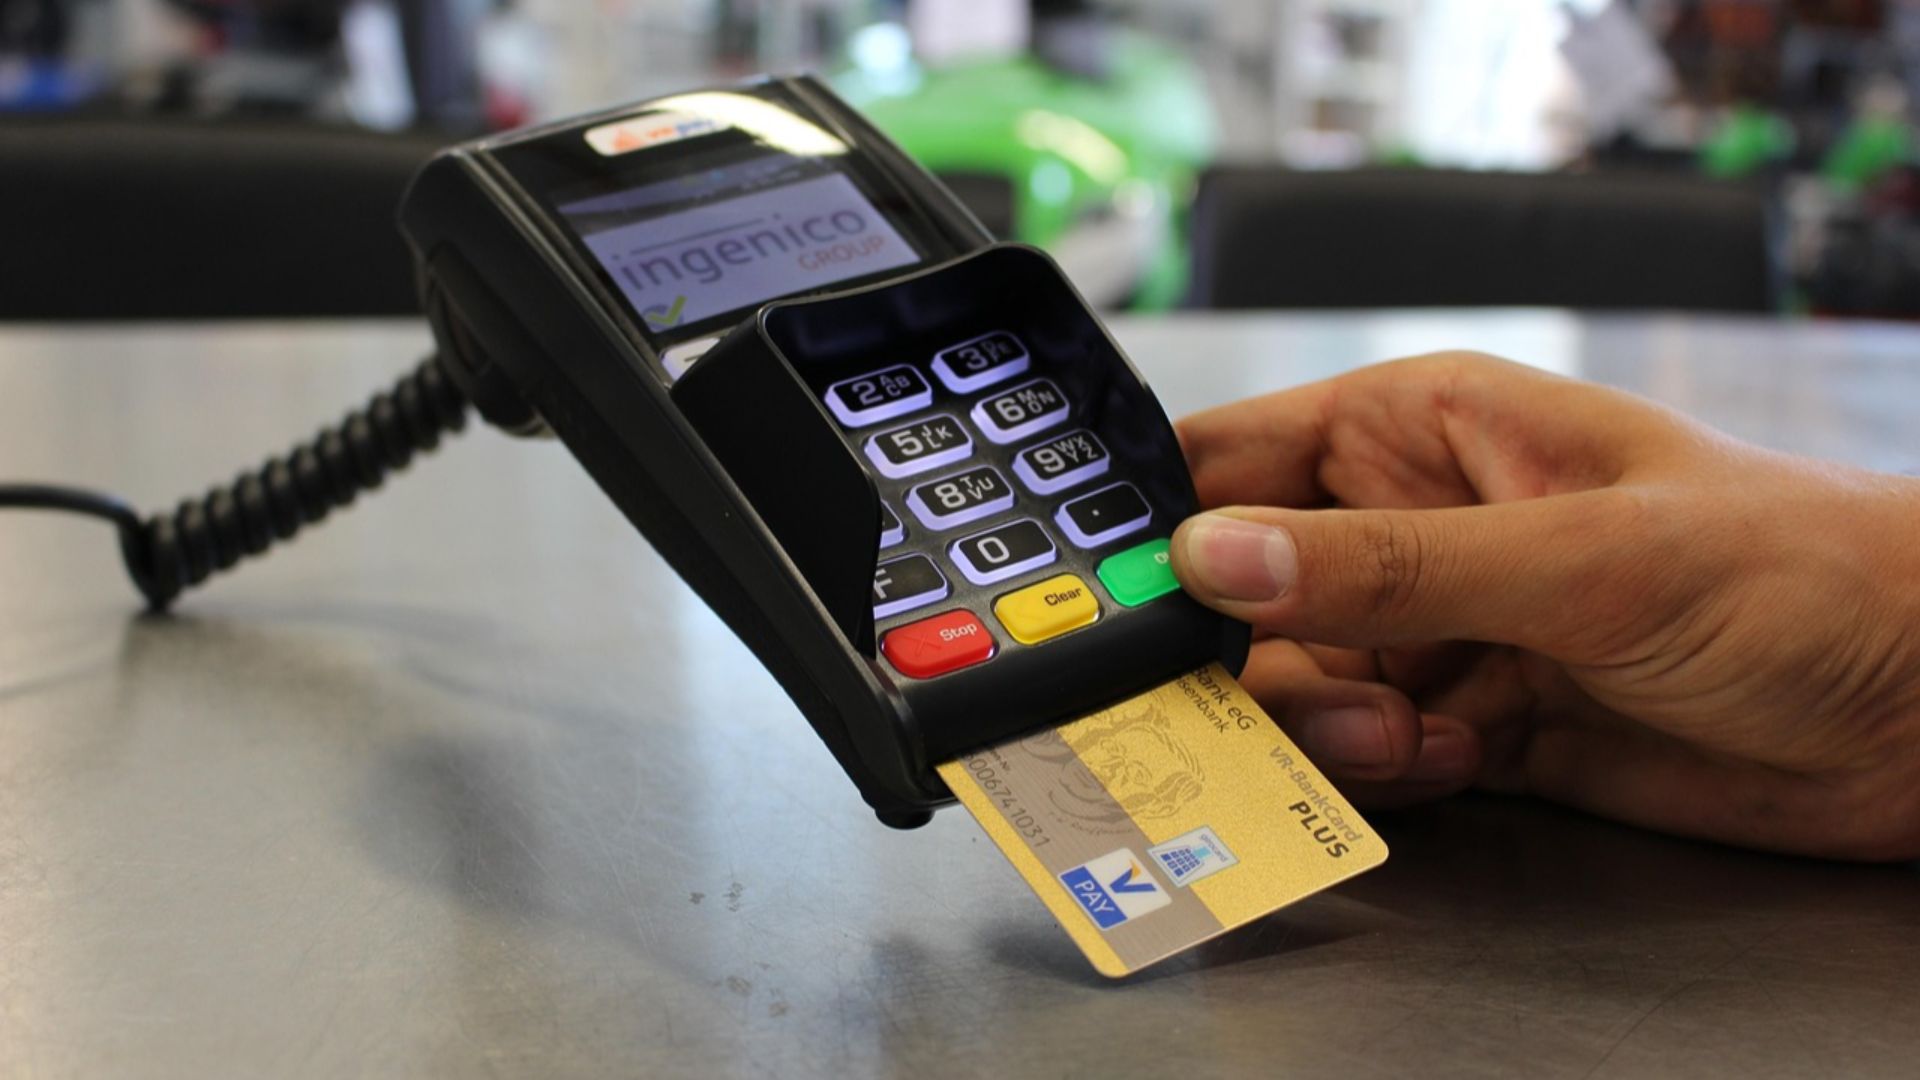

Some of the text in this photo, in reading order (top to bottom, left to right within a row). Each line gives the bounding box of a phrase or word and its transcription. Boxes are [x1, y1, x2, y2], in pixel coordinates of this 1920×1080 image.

[612, 209, 867, 291] ingenico
[798, 234, 886, 272] GROUP
[852, 380, 884, 405] 2
[995, 397, 1026, 422] 6
[890, 429, 924, 456] 5
[1033, 447, 1066, 473] 9
[934, 482, 967, 508] 8
[1043, 587, 1082, 606] Clear
[939, 622, 978, 642] Stop
[1227, 706, 1258, 731] eG
[1269, 745, 1363, 842] VR-BankCard
[1288, 800, 1350, 858] PLUS
[1074, 879, 1115, 914] PAY
